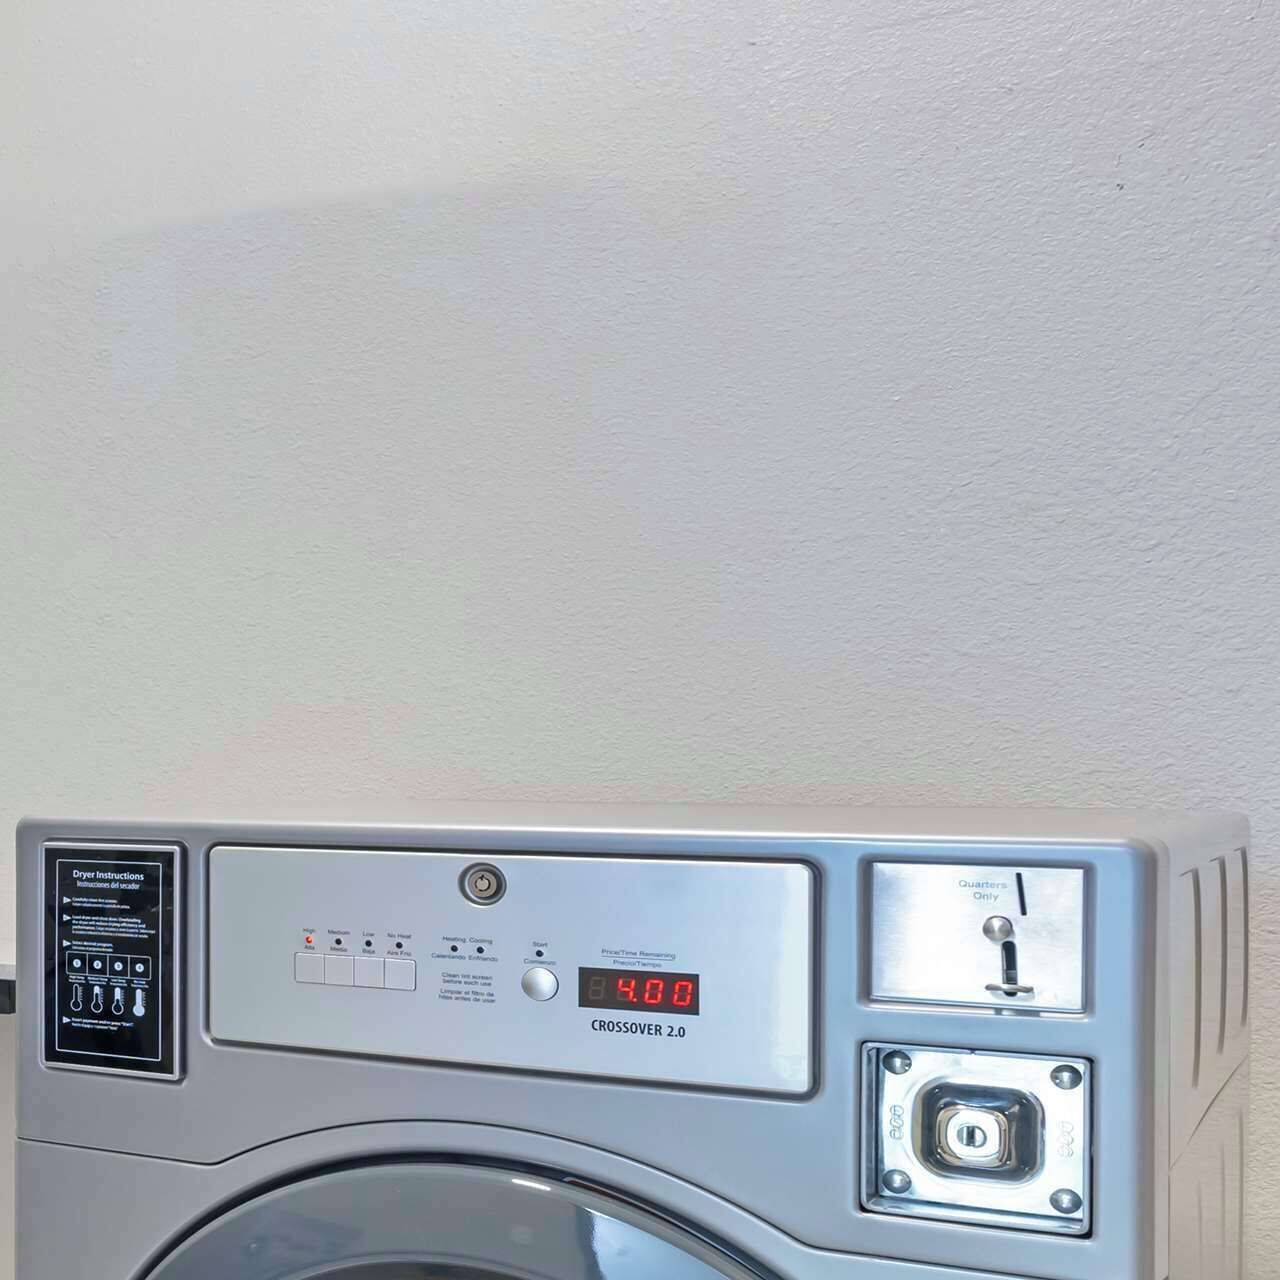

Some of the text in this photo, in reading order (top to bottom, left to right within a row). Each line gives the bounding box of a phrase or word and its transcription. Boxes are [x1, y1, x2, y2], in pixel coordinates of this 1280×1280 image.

[72, 869, 145, 881] Dryer Instructions
[76, 880, 110, 889] Instrucciones
[120, 882, 141, 890] secador
[958, 879, 1008, 890] Quarters
[973, 891, 1000, 902] Only
[442, 935, 494, 945] Heating Cooling
[430, 952, 499, 962] Calentando Enfriando
[639, 950, 677, 961] Remaining
[441, 971, 460, 979] Clean
[617, 978, 693, 1007] 4.00
[591, 1018, 687, 1039] CROSSOVER 2.0
